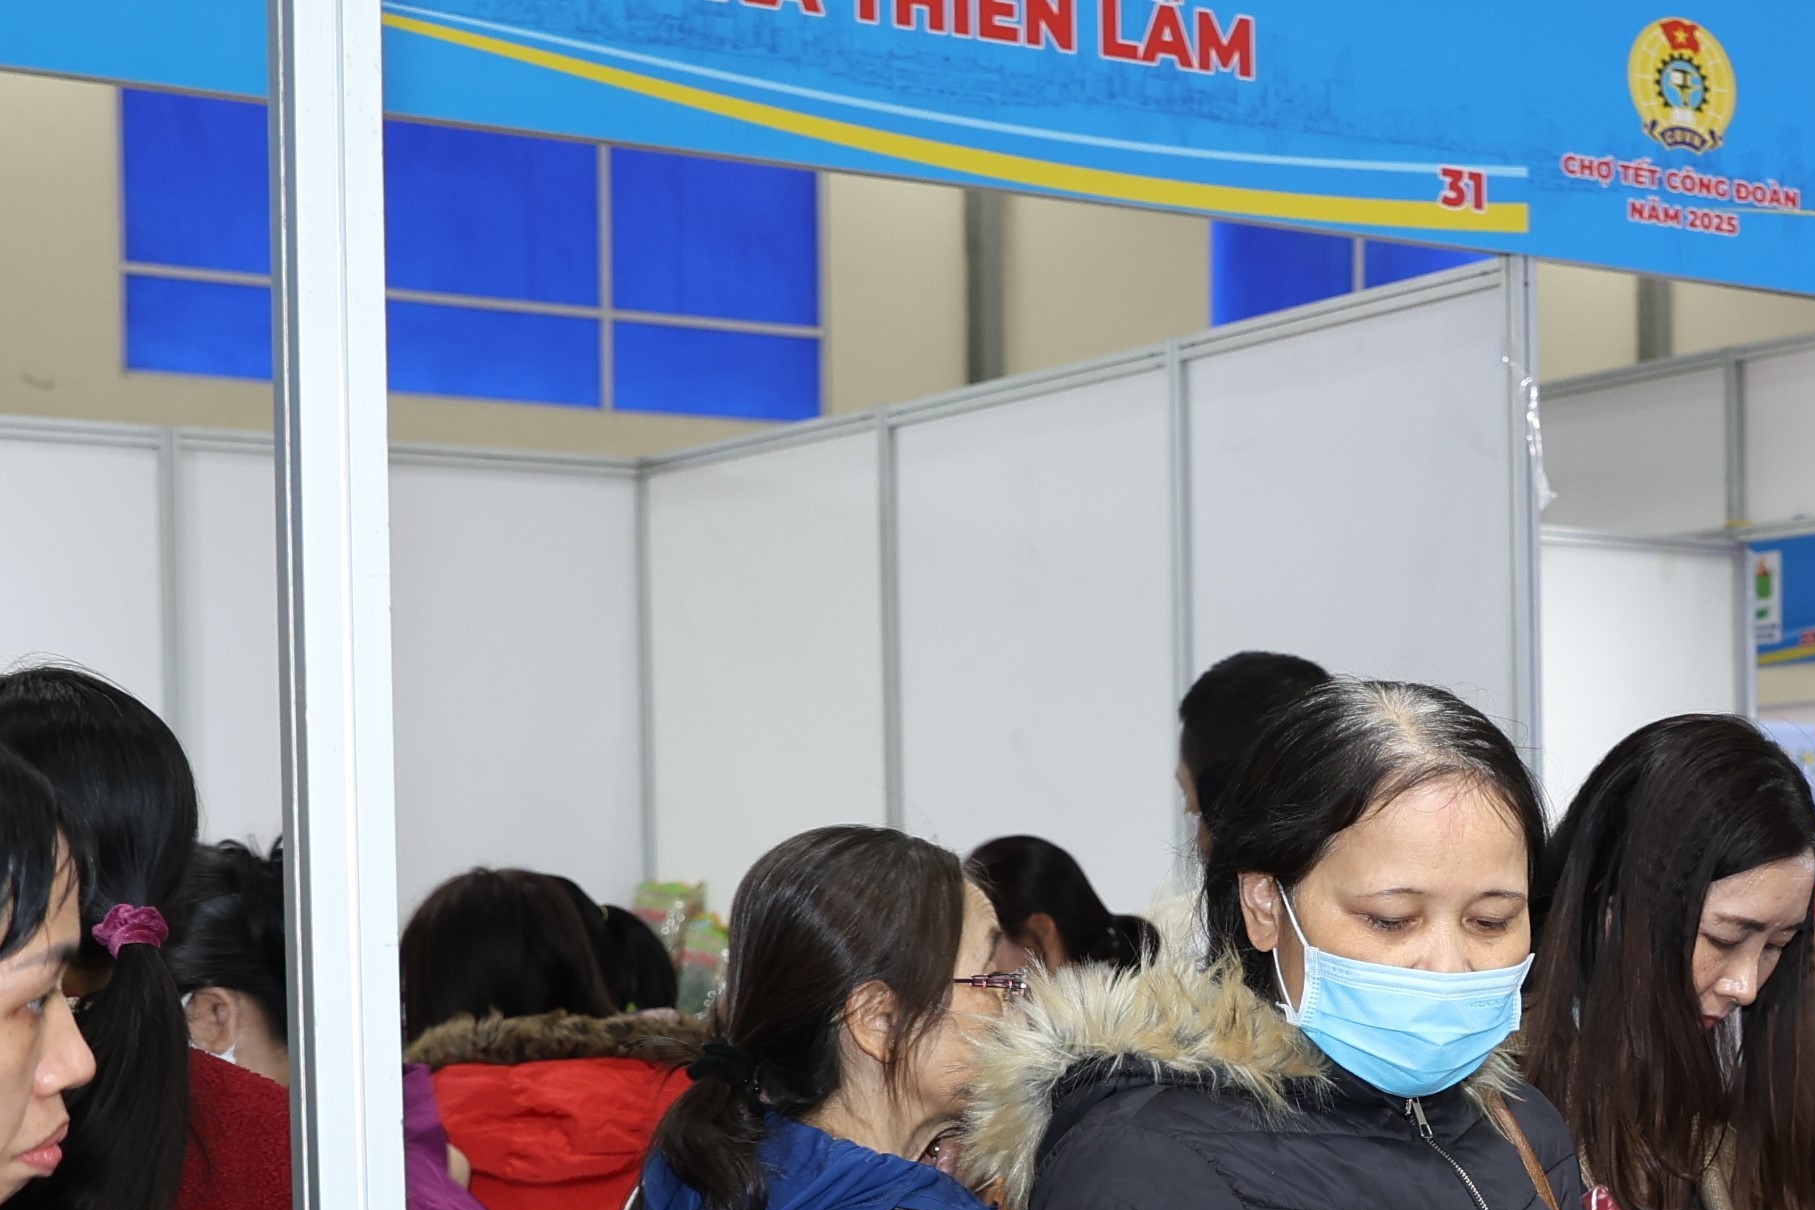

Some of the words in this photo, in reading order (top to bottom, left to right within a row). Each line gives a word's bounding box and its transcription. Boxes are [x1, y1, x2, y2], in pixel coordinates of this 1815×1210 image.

[1439, 167, 1487, 213] 31
[1561, 152, 1615, 188] CHỢ
[1618, 158, 1660, 188] TẾT
[1665, 166, 1731, 199] CÔNG
[1734, 179, 1800, 209] ĐOÀN
[1628, 195, 1681, 226] NĂM
[1687, 208, 1739, 236] 2025
